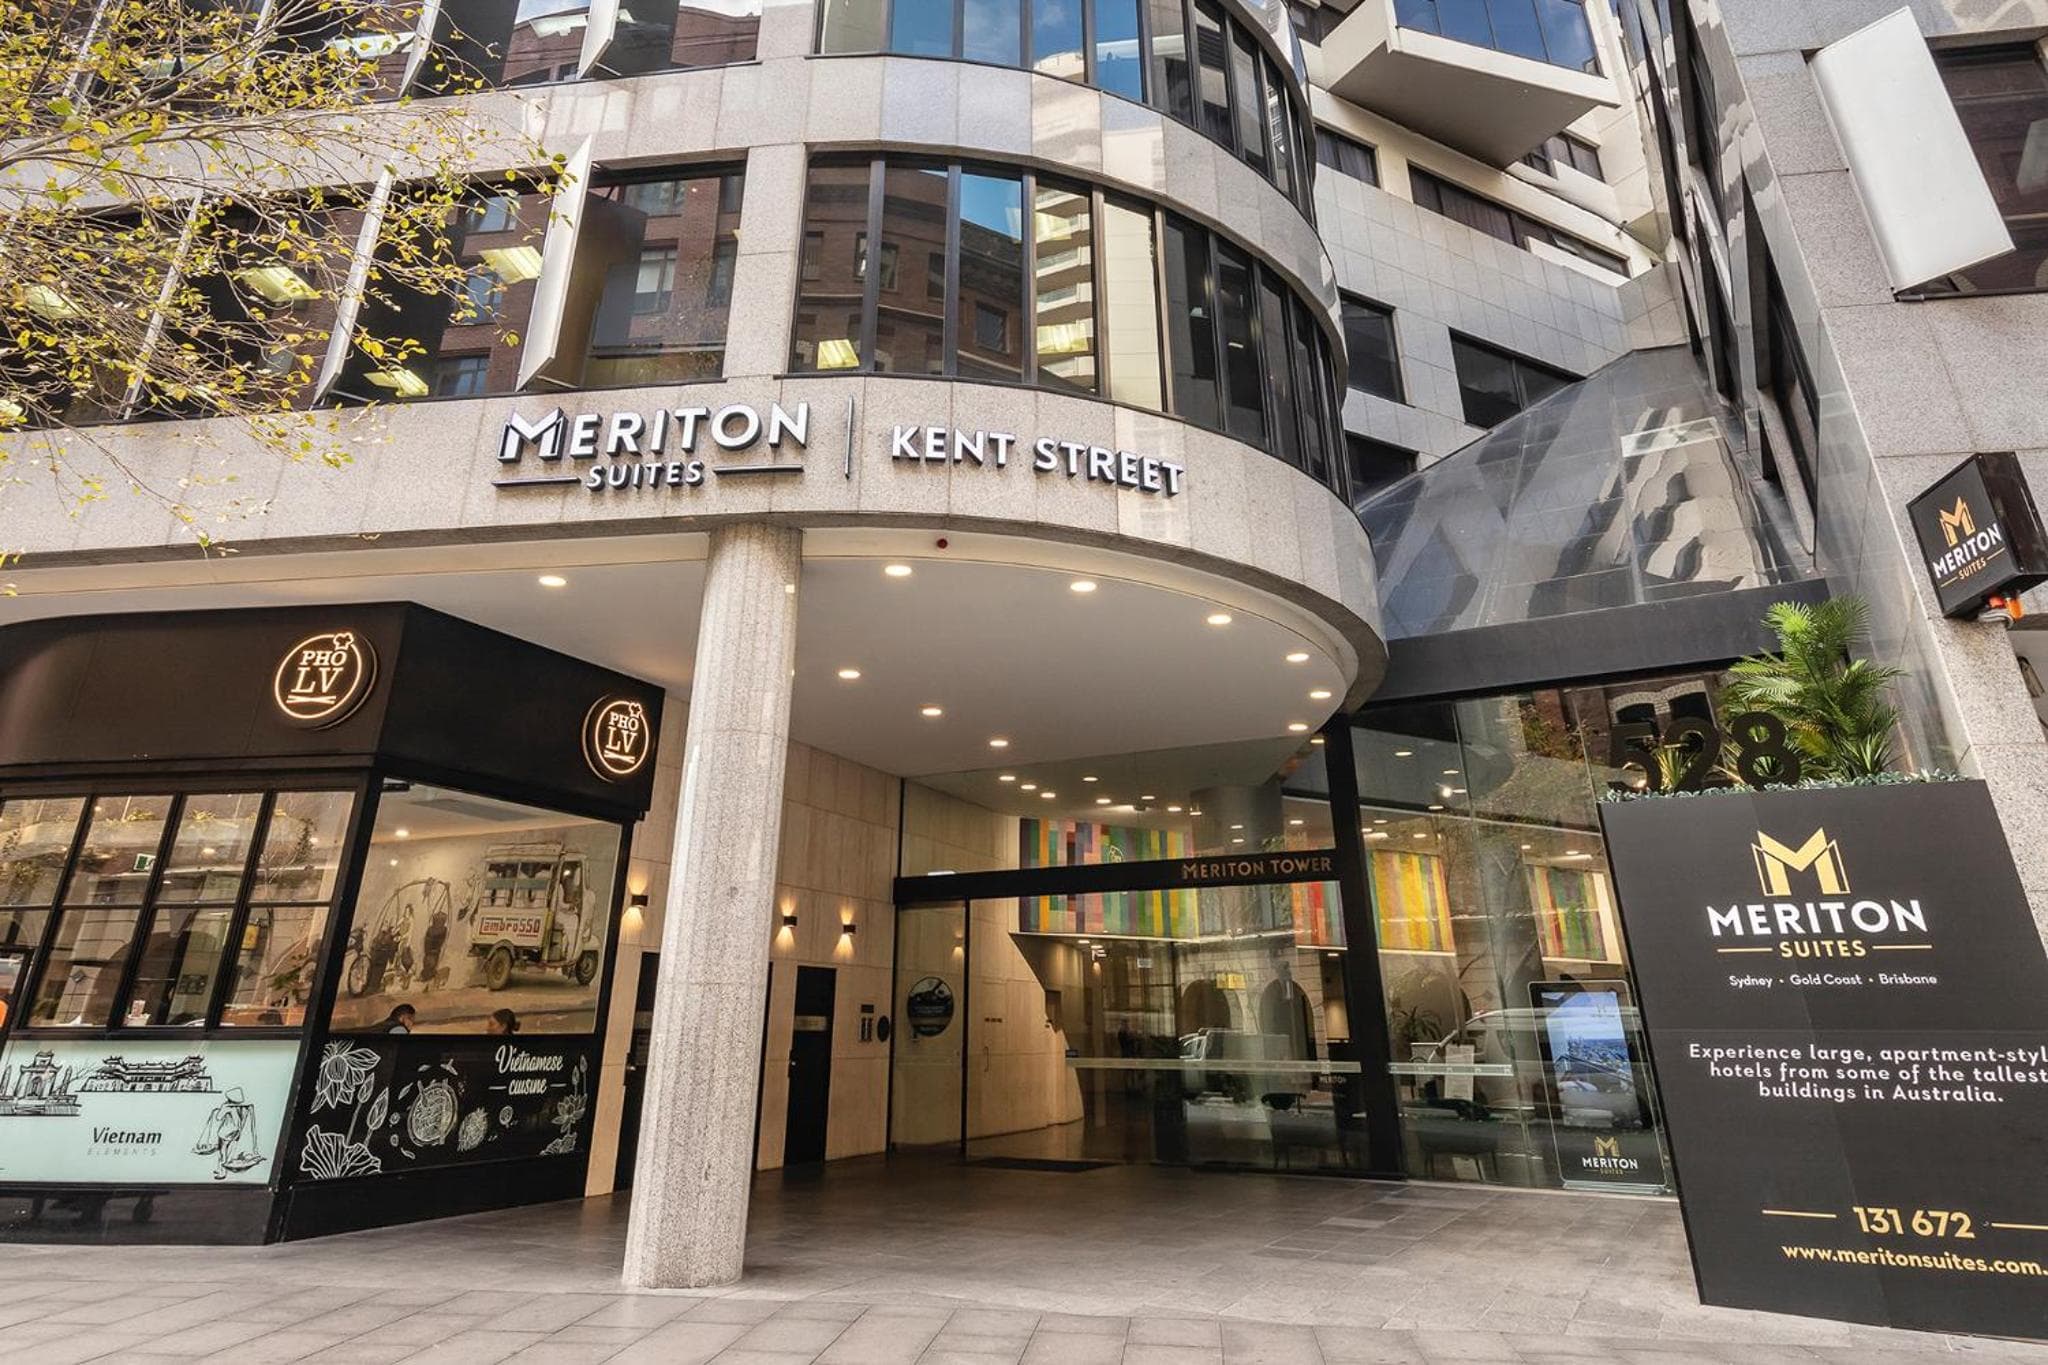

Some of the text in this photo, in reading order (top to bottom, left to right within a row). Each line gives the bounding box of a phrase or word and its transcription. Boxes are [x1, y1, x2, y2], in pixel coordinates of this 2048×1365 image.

[498, 401, 808, 463] MERITON
[892, 425, 1185, 497] KENT STREET
[586, 460, 704, 491] SUITES
[1932, 522, 2002, 579] MERITON
[1958, 557, 1987, 580] SUITES
[290, 666, 344, 694] LV
[605, 726, 638, 753] LV
[1607, 711, 1800, 794] 528
[1181, 857, 1333, 880] MERITON TOWER
[1706, 899, 1929, 937] MERITON
[1779, 940, 1867, 957] SUITES
[1729, 973, 1938, 989] Sydney Gold Coast Brisbane
[495, 1045, 563, 1074] Vietnamese
[1689, 1044, 1802, 1062] Experience
[1810, 1044, 1873, 1064] large,
[1710, 1061, 2048, 1084] hotels from some of the tallest
[508, 1079, 547, 1095] cuisine
[1759, 1081, 2004, 1103] buildings in Australia.
[93, 1127, 162, 1144] Vietnam
[1582, 1157, 1639, 1170] MERITON
[1852, 1206, 1976, 1239] 131 672
